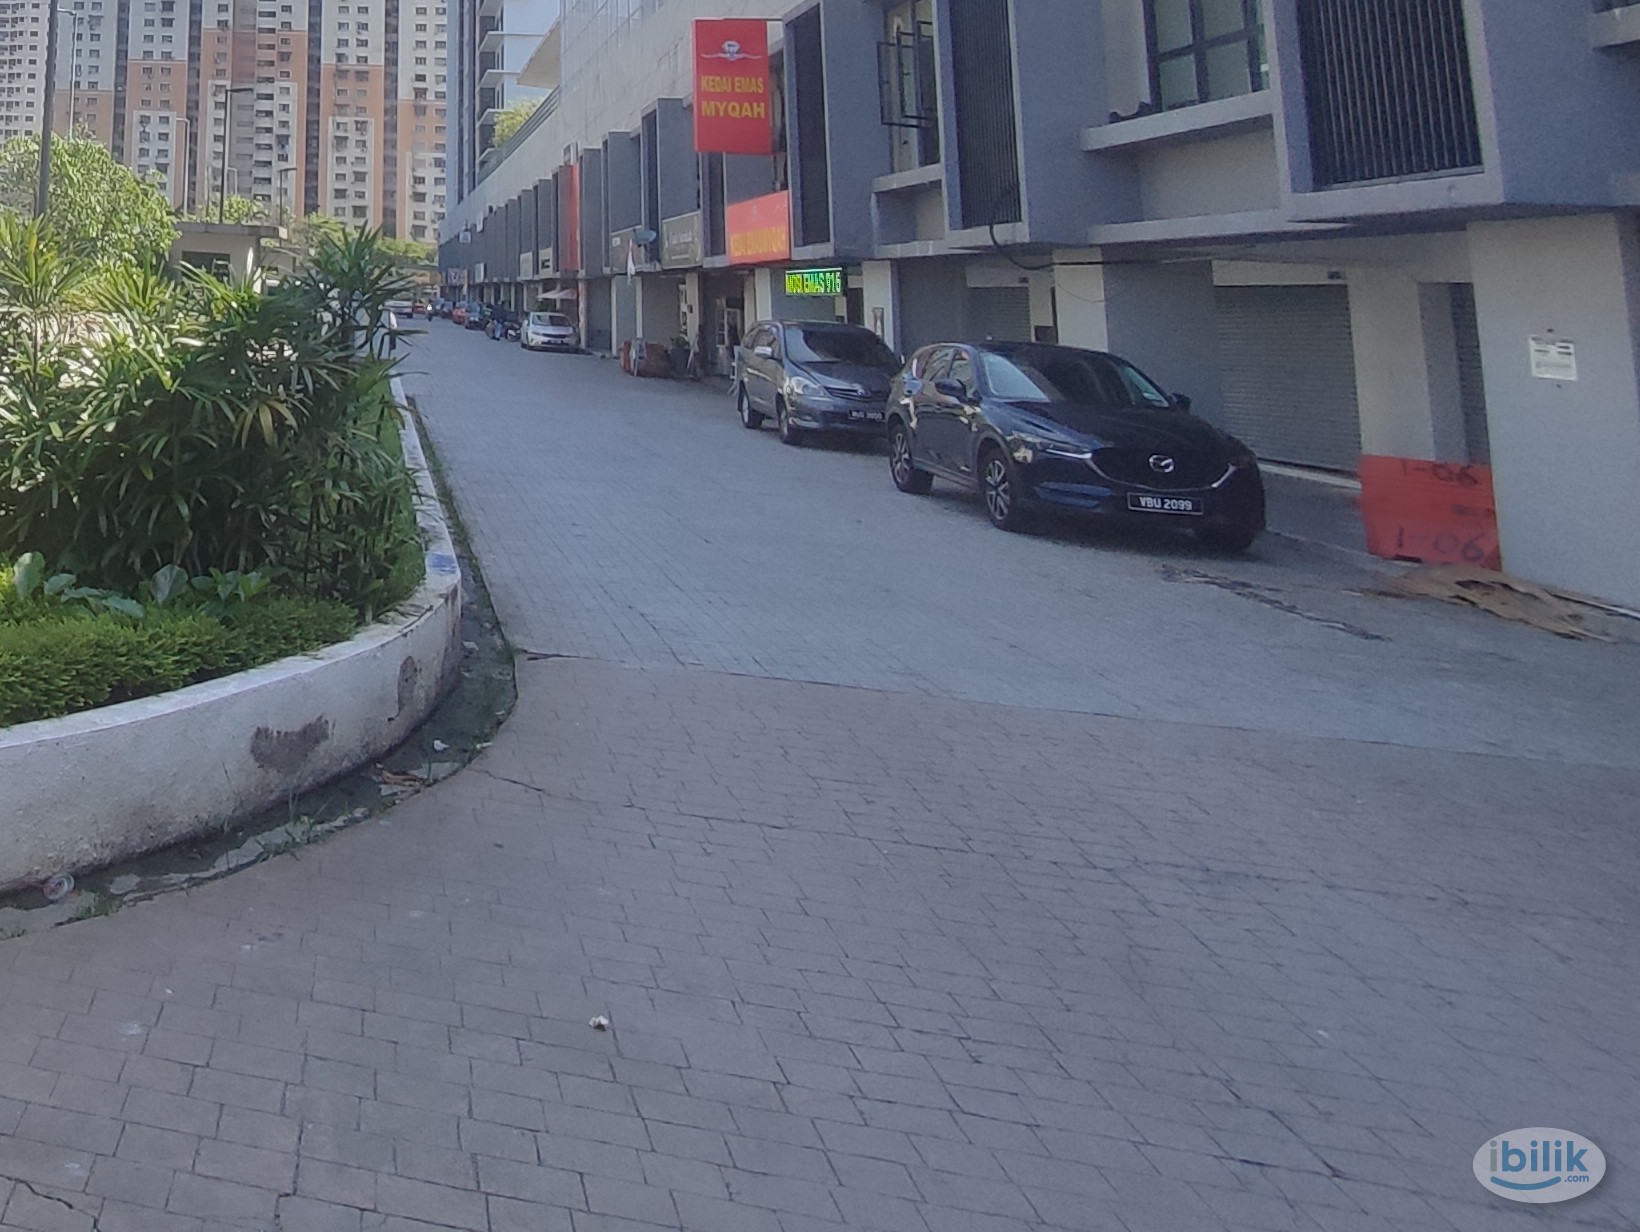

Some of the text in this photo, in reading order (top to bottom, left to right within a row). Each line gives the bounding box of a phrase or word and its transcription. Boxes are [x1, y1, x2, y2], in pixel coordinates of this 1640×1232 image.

[701, 75, 764, 94] KEDAI EMAS
[702, 101, 765, 119] MYQAH
[1139, 496, 1193, 511] VBU 2099
